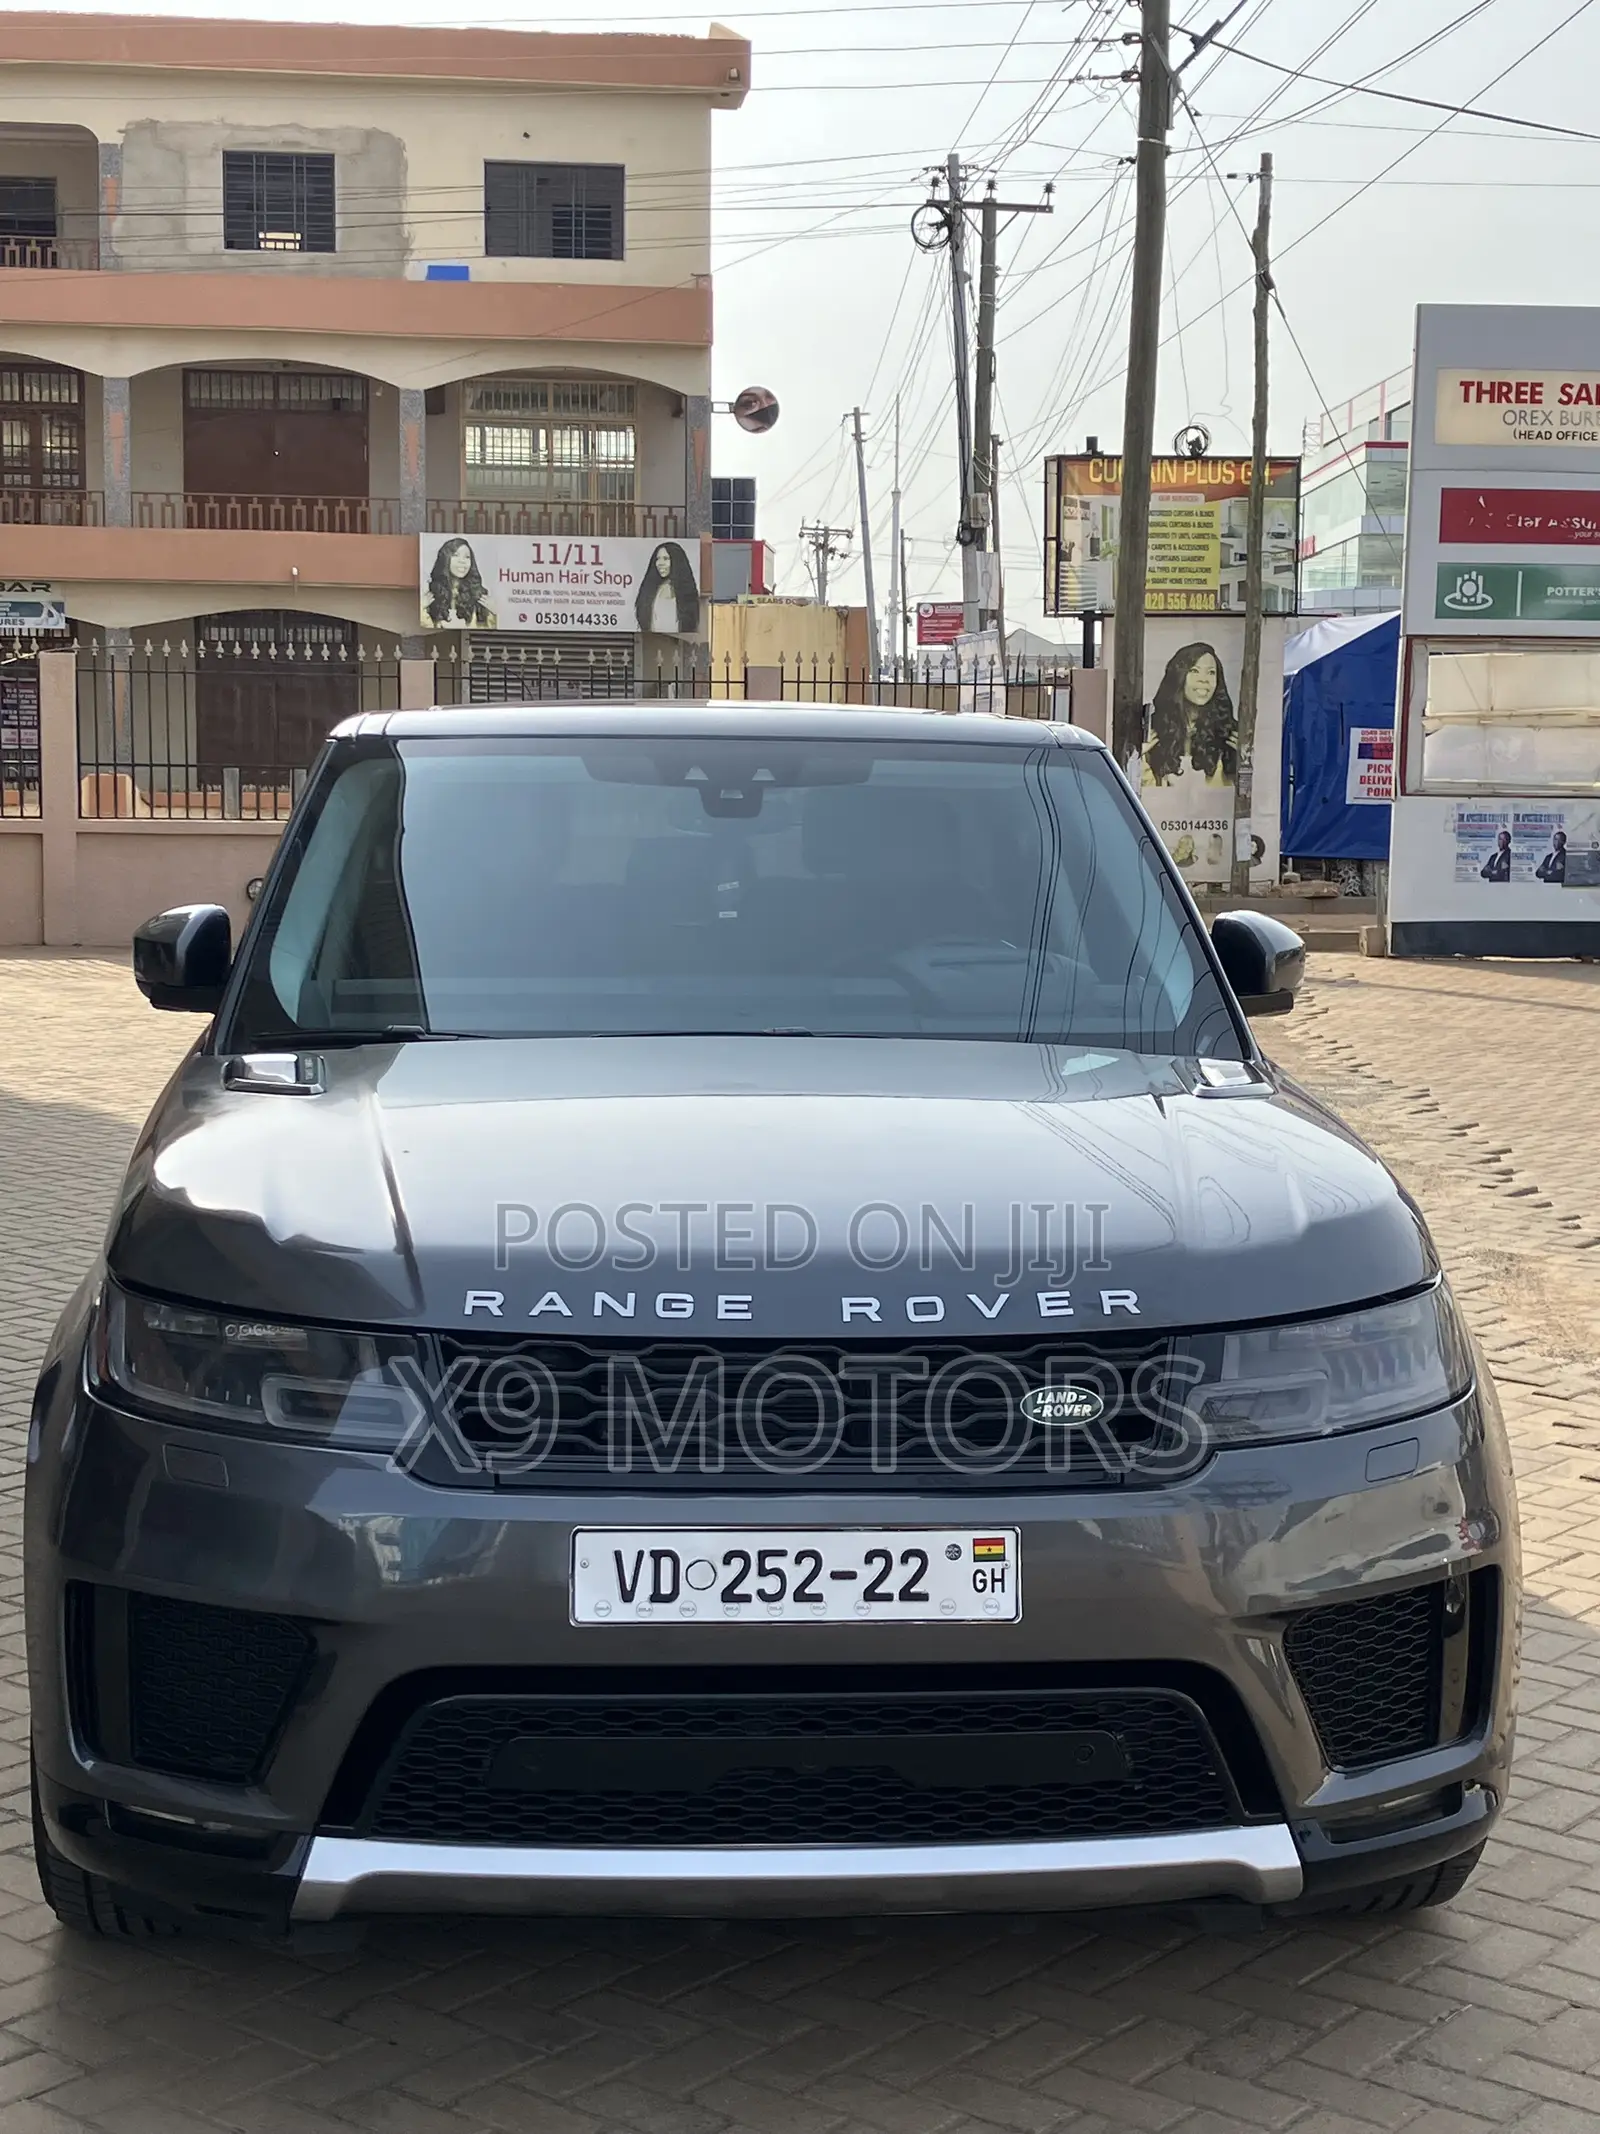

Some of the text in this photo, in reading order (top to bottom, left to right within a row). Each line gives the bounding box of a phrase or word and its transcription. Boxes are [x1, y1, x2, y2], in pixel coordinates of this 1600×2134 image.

[1459, 381, 1544, 404] THREE
[1502, 409, 1554, 426] OREX
[1513, 428, 1598, 441] (HEAD OFFICE
[1184, 460, 1236, 485] PLUS
[532, 543, 604, 566] 11/11
[499, 568, 633, 588] Human Hair Shop
[512, 588, 541, 596] DEALERS
[1145, 592, 1215, 610] 020 556 4848
[535, 612, 618, 626] 0530144336
[1367, 764, 1392, 774] PICK
[1160, 820, 1229, 831] 0530144336
[463, 1288, 1142, 1325] RANGE ROVER
[1036, 1391, 1078, 1404] LAND
[1041, 1404, 1092, 1417] ROVER
[614, 1548, 930, 1603] VD 252-22
[972, 1567, 1006, 1594] GH
